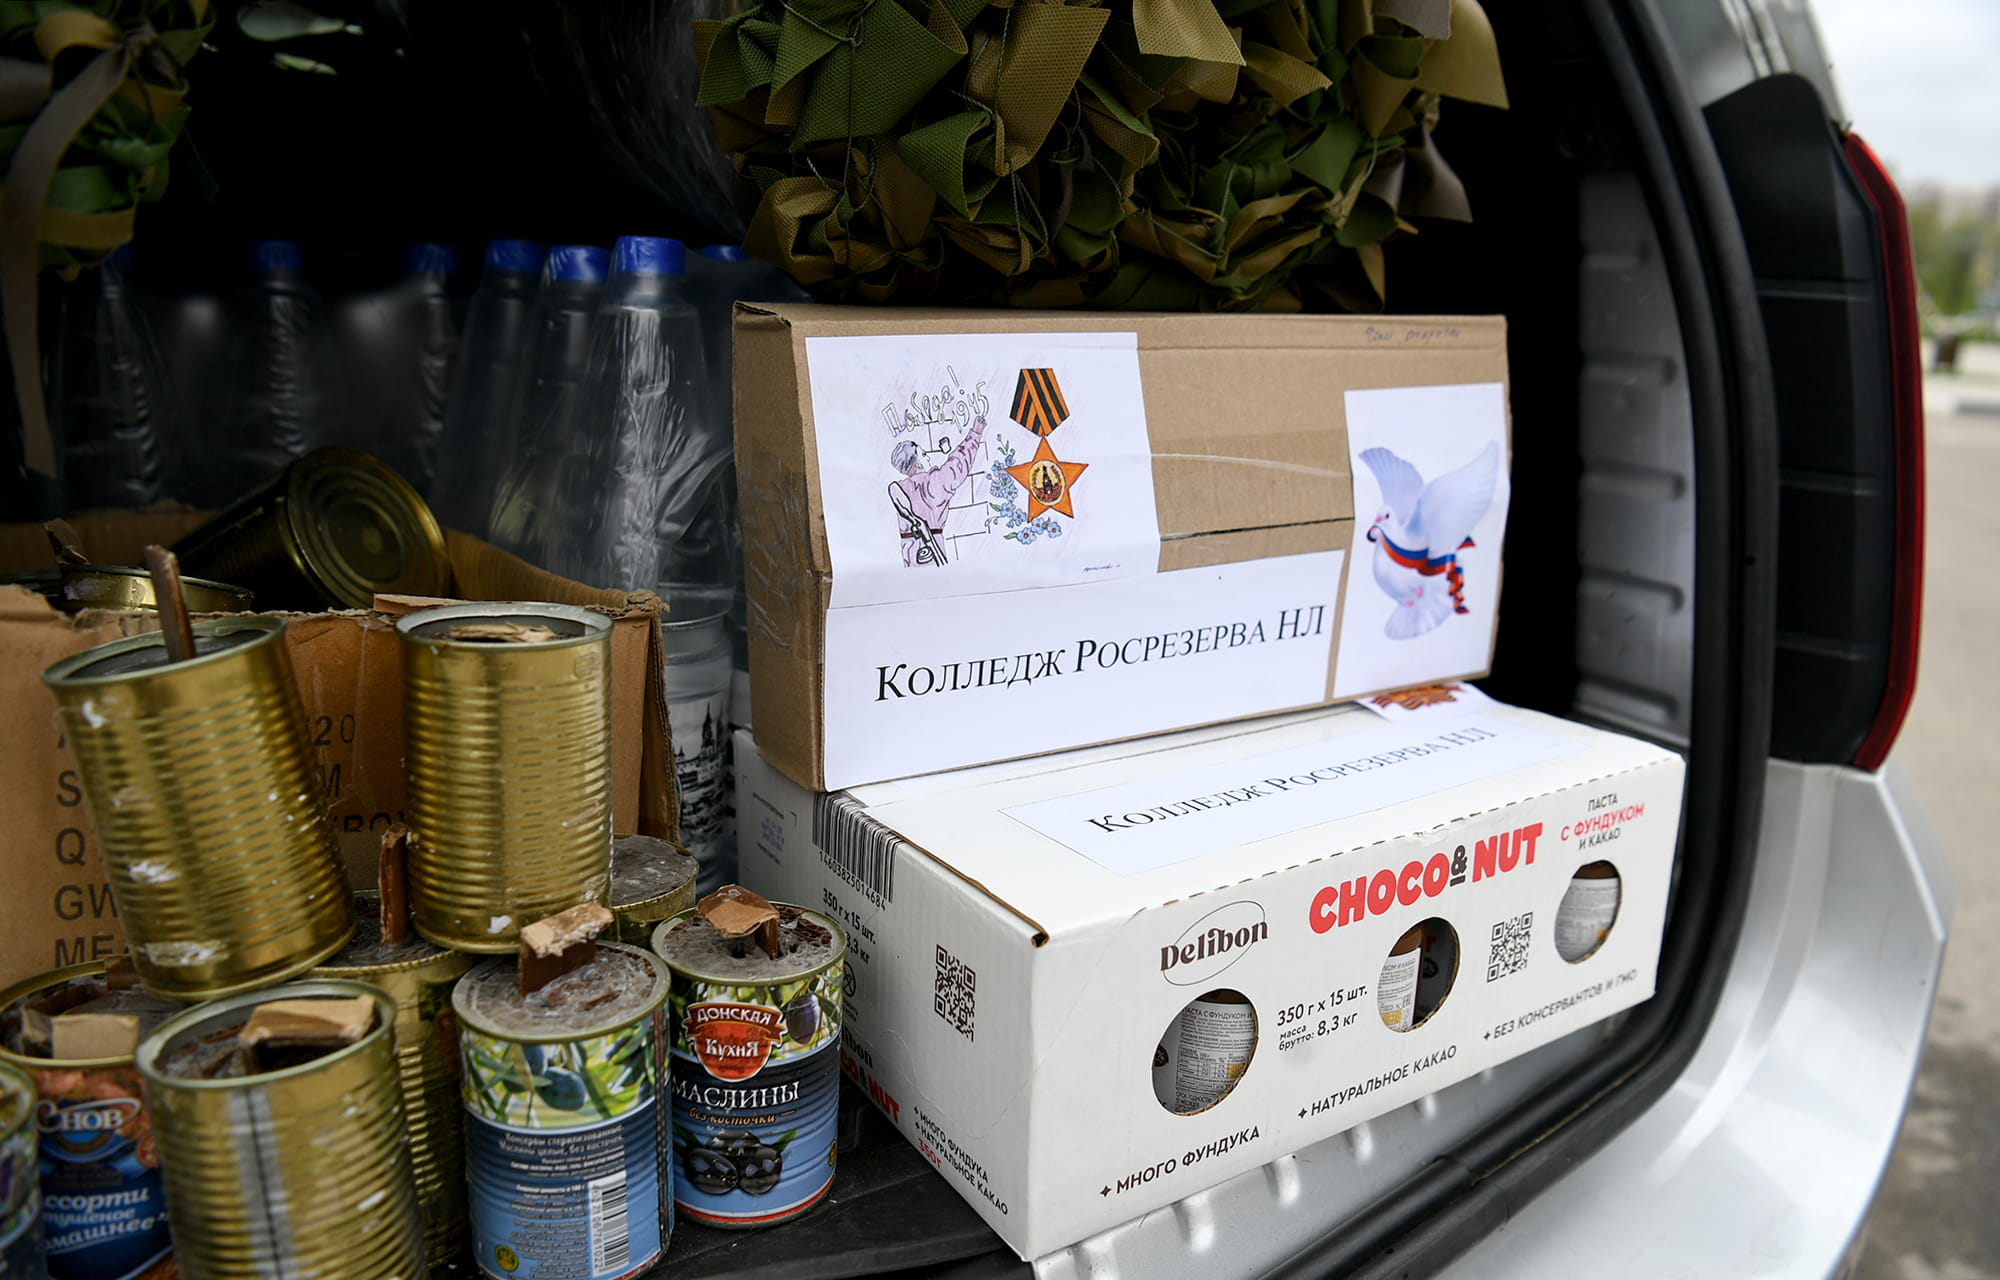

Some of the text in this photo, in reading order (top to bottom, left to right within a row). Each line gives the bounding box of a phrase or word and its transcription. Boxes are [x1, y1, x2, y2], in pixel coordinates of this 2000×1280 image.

[1277, 604, 1327, 640] НЛ
[1438, 726, 1499, 748] НЛ
[1574, 802, 1646, 837] ФУНДУКОМ
[1588, 793, 1618, 813] ПАСТА
[1579, 827, 1621, 851] И КАКАО
[822, 887, 839, 913] 350
[852, 911, 861, 931] 15
[861, 925, 876, 945] шт.
[1160, 920, 1269, 972] Delibon
[697, 1006, 773, 1026] ДОНСКАЯ
[1277, 1003, 1305, 1027] 350
[1308, 1004, 1315, 1016] г
[1330, 988, 1344, 1007] 15
[1346, 985, 1368, 1002] шт.
[1494, 1020, 1515, 1039] БЕЗ
[1517, 983, 1603, 1029] КОНСЕРВАНТОВ
[1615, 968, 1638, 987] ГМО
[1279, 1013, 1358, 1051] брутто: 8,3 кг
[1279, 1025, 1307, 1041] масса
[671, 1074, 801, 1109] МАСЛИНЫ
[1310, 1044, 1458, 1117] НАТУРАЛЬНОЕ КАКАО
[688, 1106, 777, 1126] без косточки
[920, 1109, 989, 1184] МНОГО ФУНДУКА
[1116, 1125, 1261, 1195] МНОГО ФУНДУКА
[920, 1124, 1009, 1216] НАТУРАЛЬНОЕ КАКАО
[45, 1187, 150, 1214] ссорти
